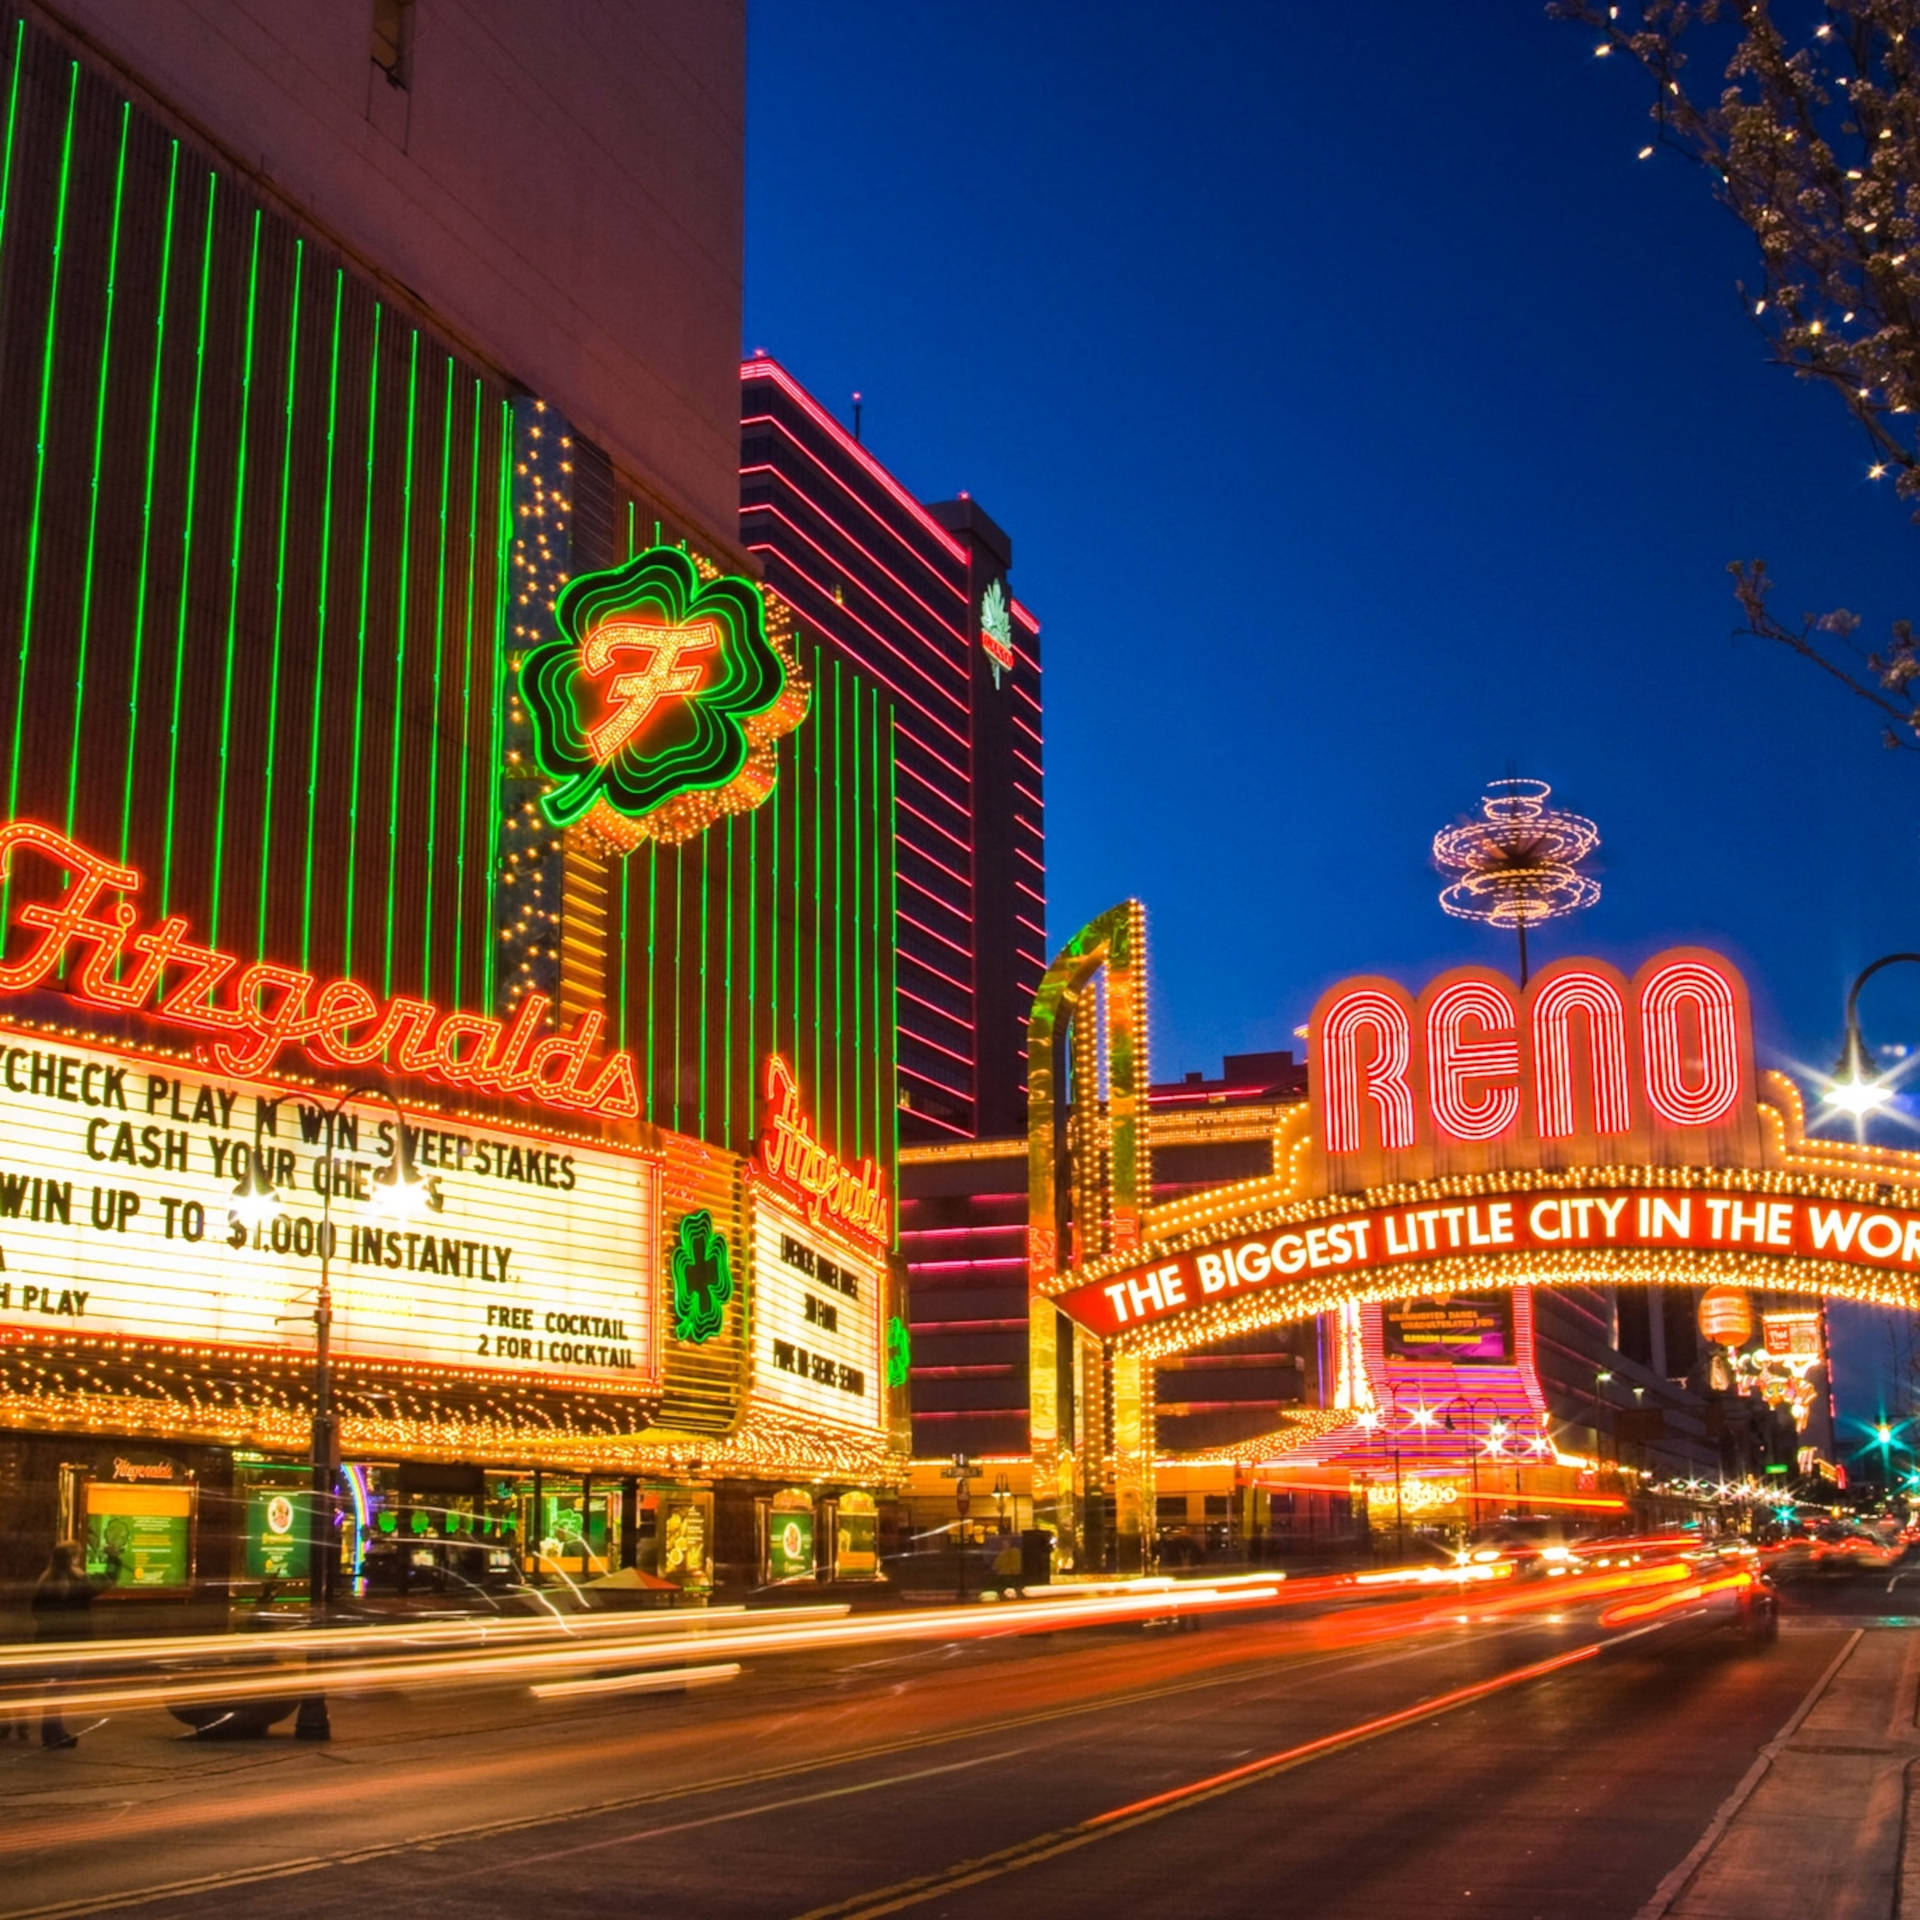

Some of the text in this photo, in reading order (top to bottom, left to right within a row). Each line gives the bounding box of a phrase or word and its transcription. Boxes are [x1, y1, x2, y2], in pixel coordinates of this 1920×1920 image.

[583, 622, 717, 764] F
[0, 823, 639, 1118] Fitzgeralds
[147, 1074, 238, 1129] PLAY
[256, 1096, 277, 1138] N
[1322, 961, 1739, 1152] RENO
[86, 1117, 189, 1172] CASH
[208, 1135, 297, 1190] YOUR
[764, 1056, 889, 1245] Fitzgeralds
[0, 1172, 72, 1225] WIN
[91, 1186, 141, 1232] UP
[160, 1196, 205, 1243] TO
[351, 1224, 512, 1283] INSTANTLY
[1104, 1265, 1186, 1323] THE
[1195, 1219, 1371, 1294] BIGGEST
[1384, 1202, 1514, 1256] LITTLE
[1529, 1196, 1628, 1240] CITY
[1638, 1197, 1691, 1239] IN
[1705, 1199, 1793, 1245] THE
[23, 1285, 89, 1316] PLAY
[477, 1334, 490, 1356] 2
[496, 1336, 533, 1359] FOR
[550, 1342, 636, 1370] COCKTAIL
[487, 1305, 628, 1340] FREE COCKTAIL
